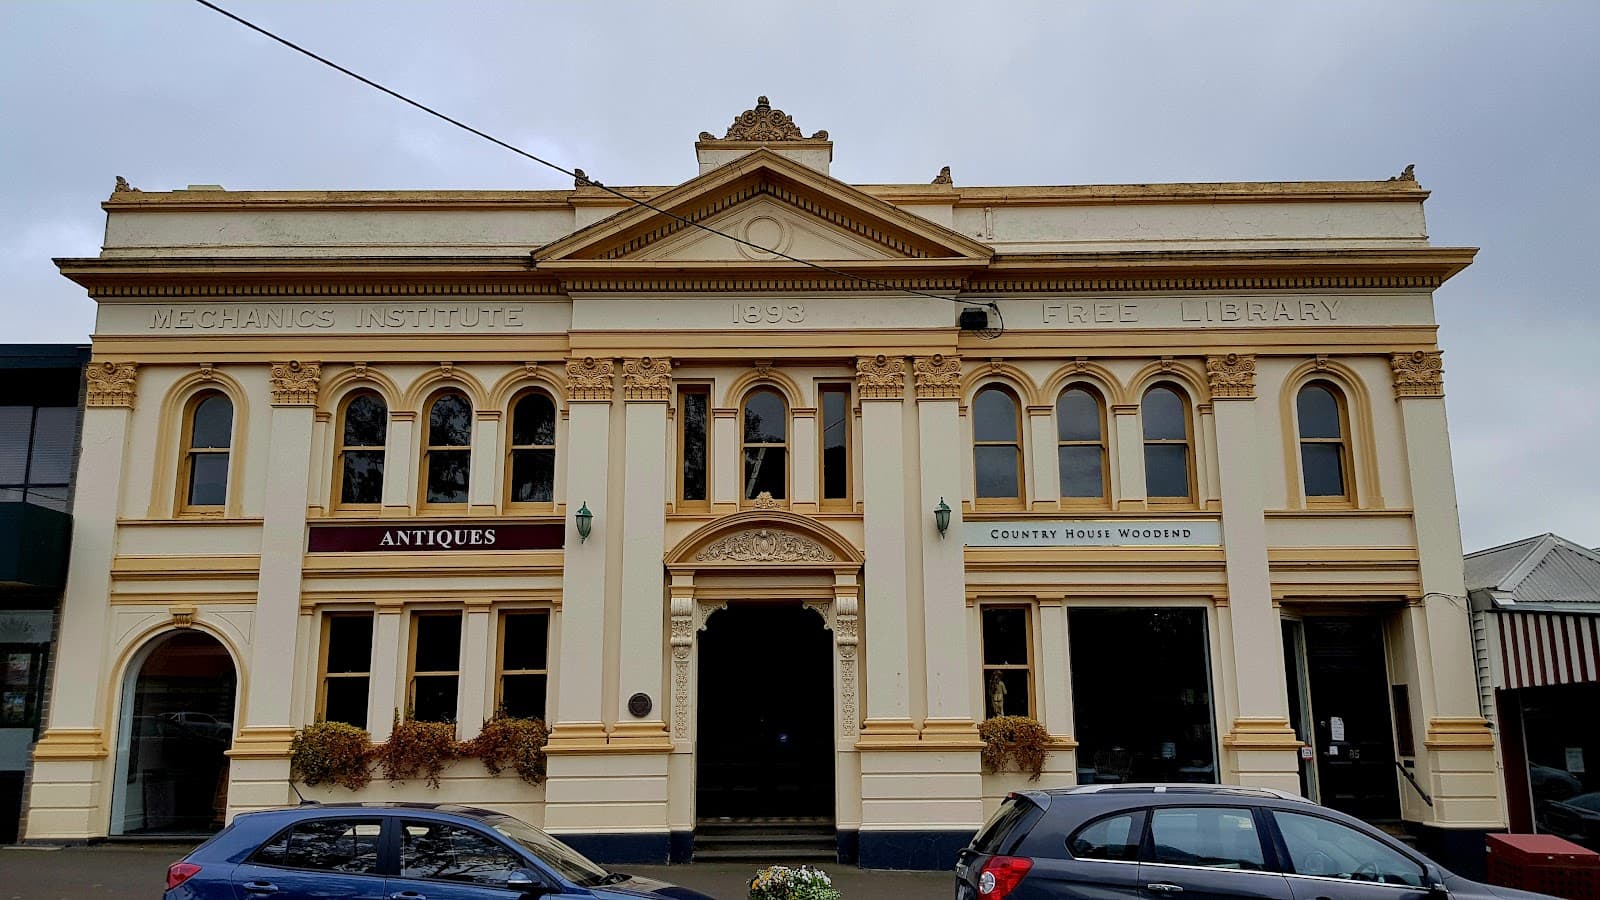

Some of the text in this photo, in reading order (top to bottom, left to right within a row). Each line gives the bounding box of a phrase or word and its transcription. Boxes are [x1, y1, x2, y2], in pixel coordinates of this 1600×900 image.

[149, 305, 525, 329] MECHANICS INSTITUTE
[732, 303, 806, 324] 1893
[1042, 300, 1340, 324] FREE LIBRARY
[379, 529, 497, 549] ANTIQUES
[990, 528, 1192, 539] COUNTRY HOUSE WOODEND
